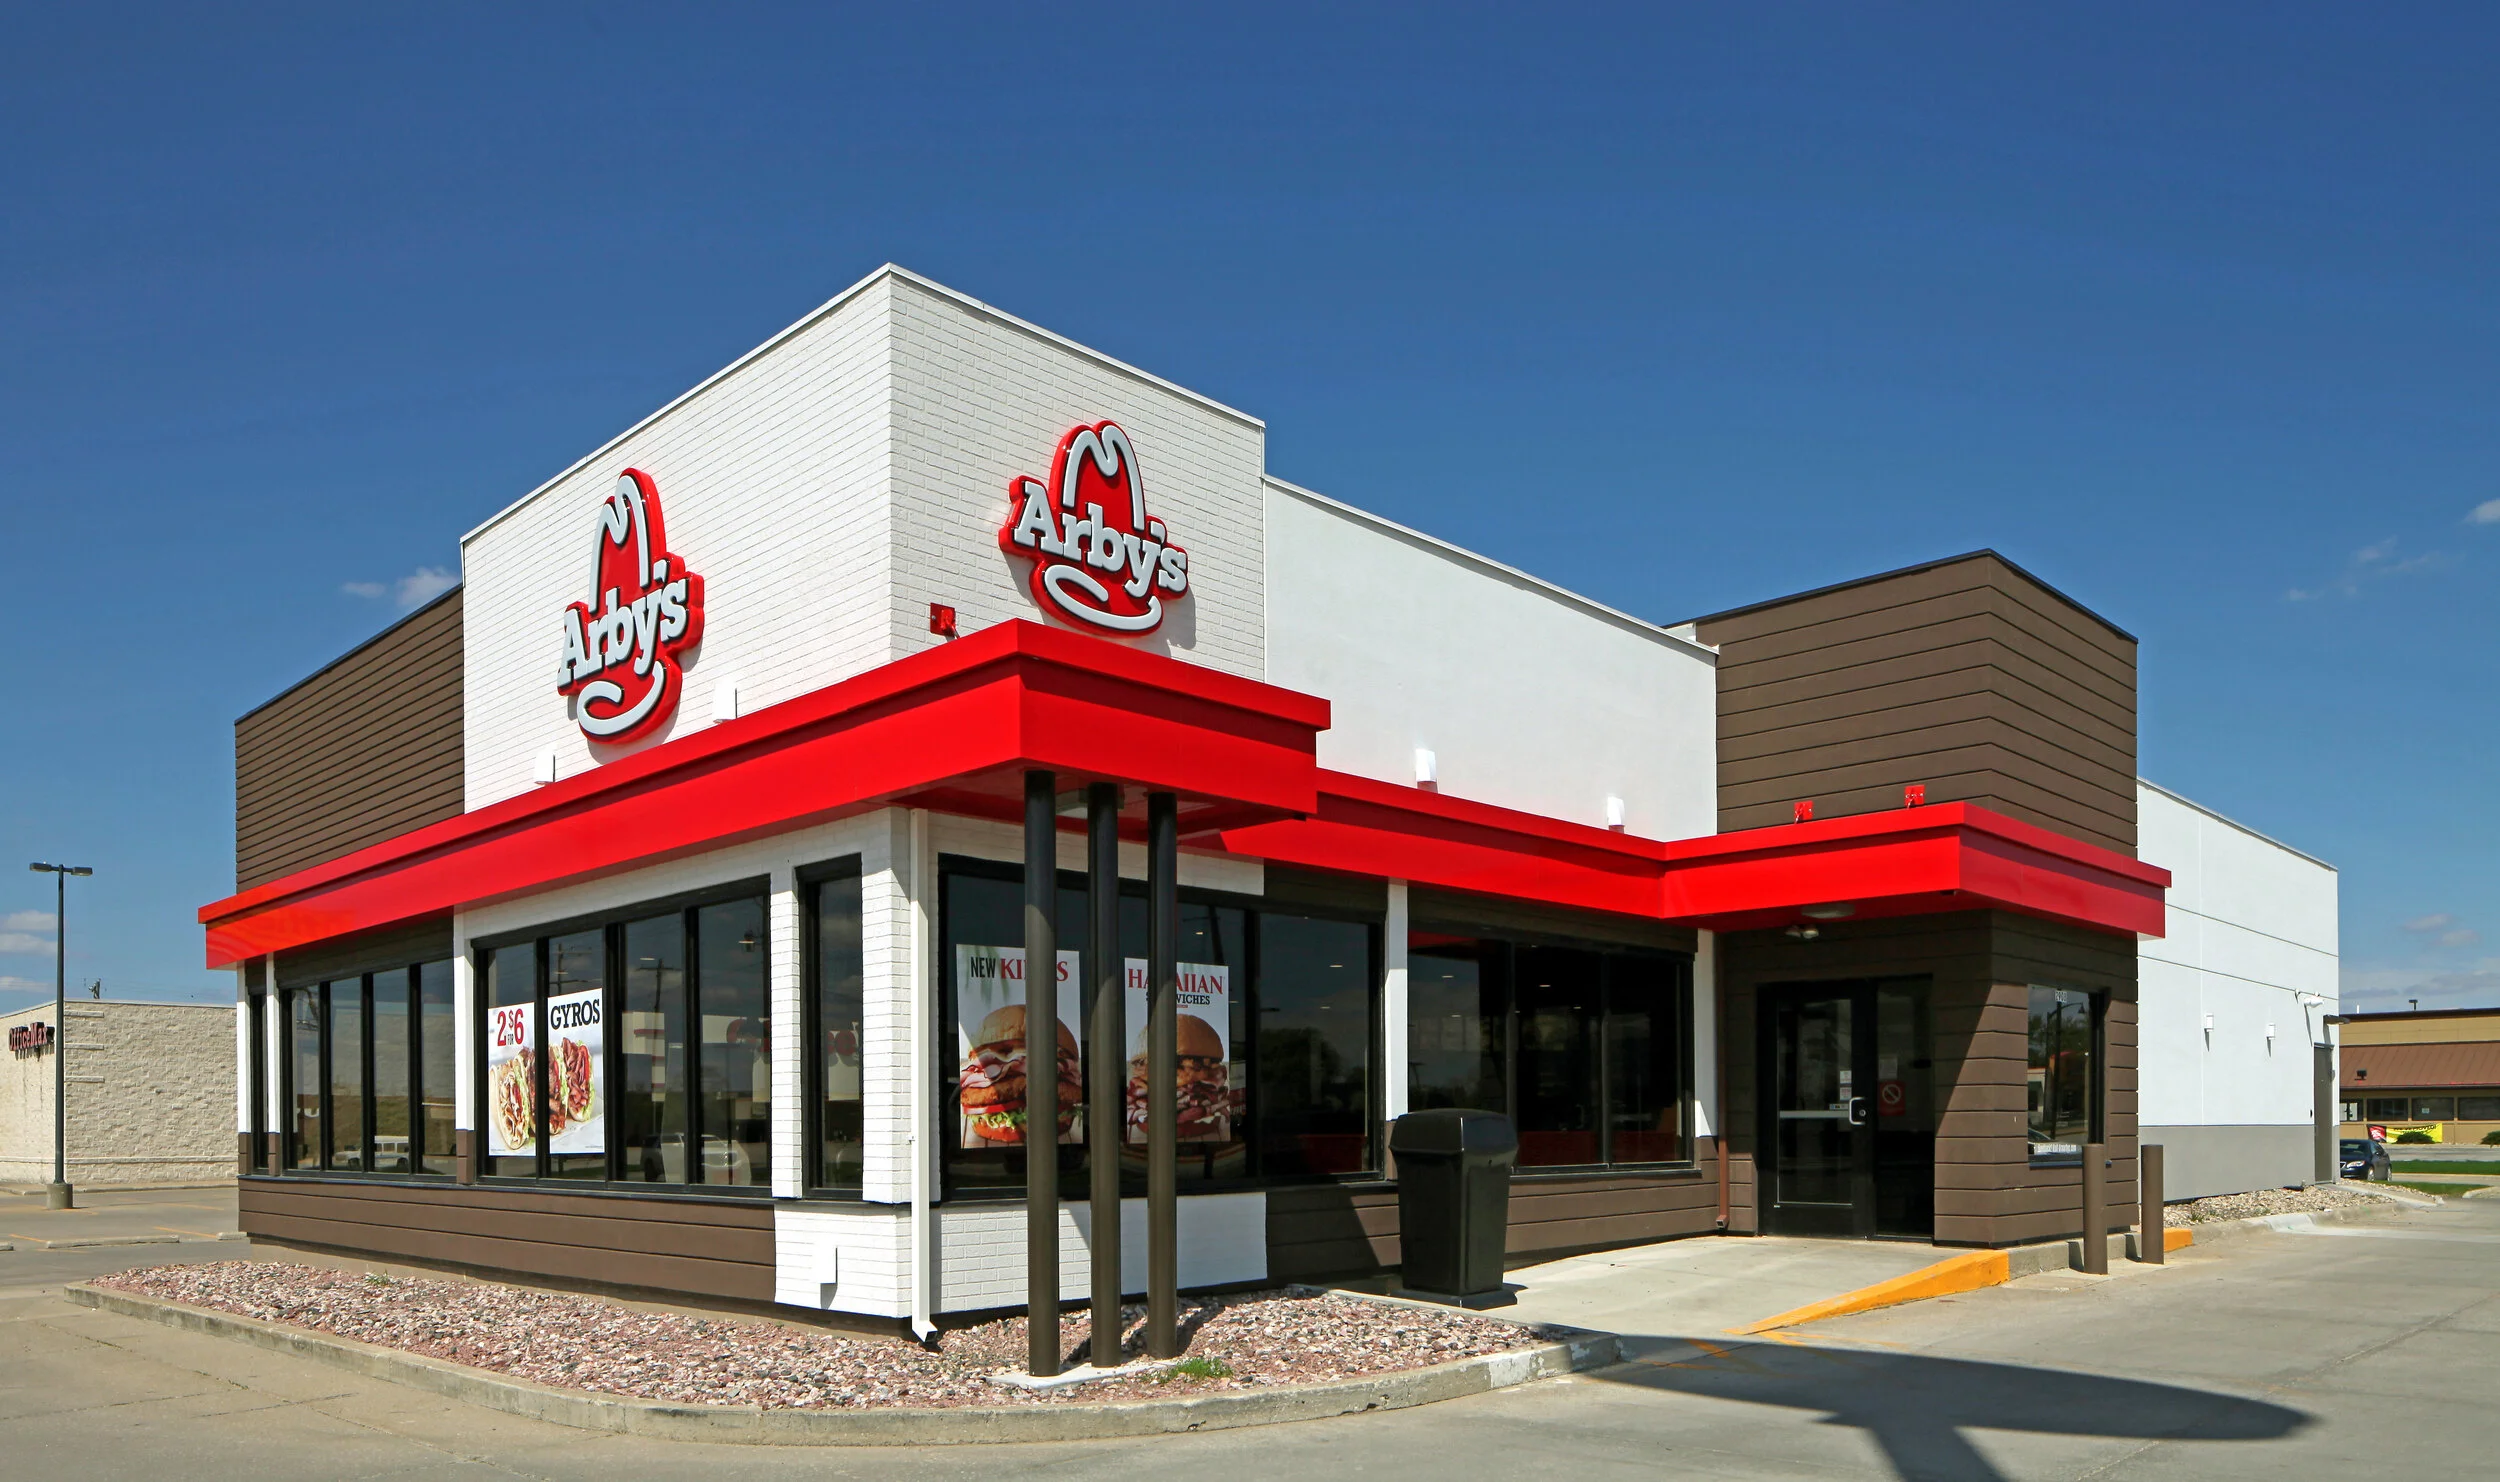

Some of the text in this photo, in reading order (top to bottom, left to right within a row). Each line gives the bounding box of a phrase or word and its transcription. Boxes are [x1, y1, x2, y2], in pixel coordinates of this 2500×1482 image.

[1013, 480, 1187, 599] Arby's
[557, 558, 687, 687] Arby's
[970, 956, 1069, 982] NEW KIS
[497, 1010, 507, 1047] 2
[550, 998, 601, 1031] GYROS
